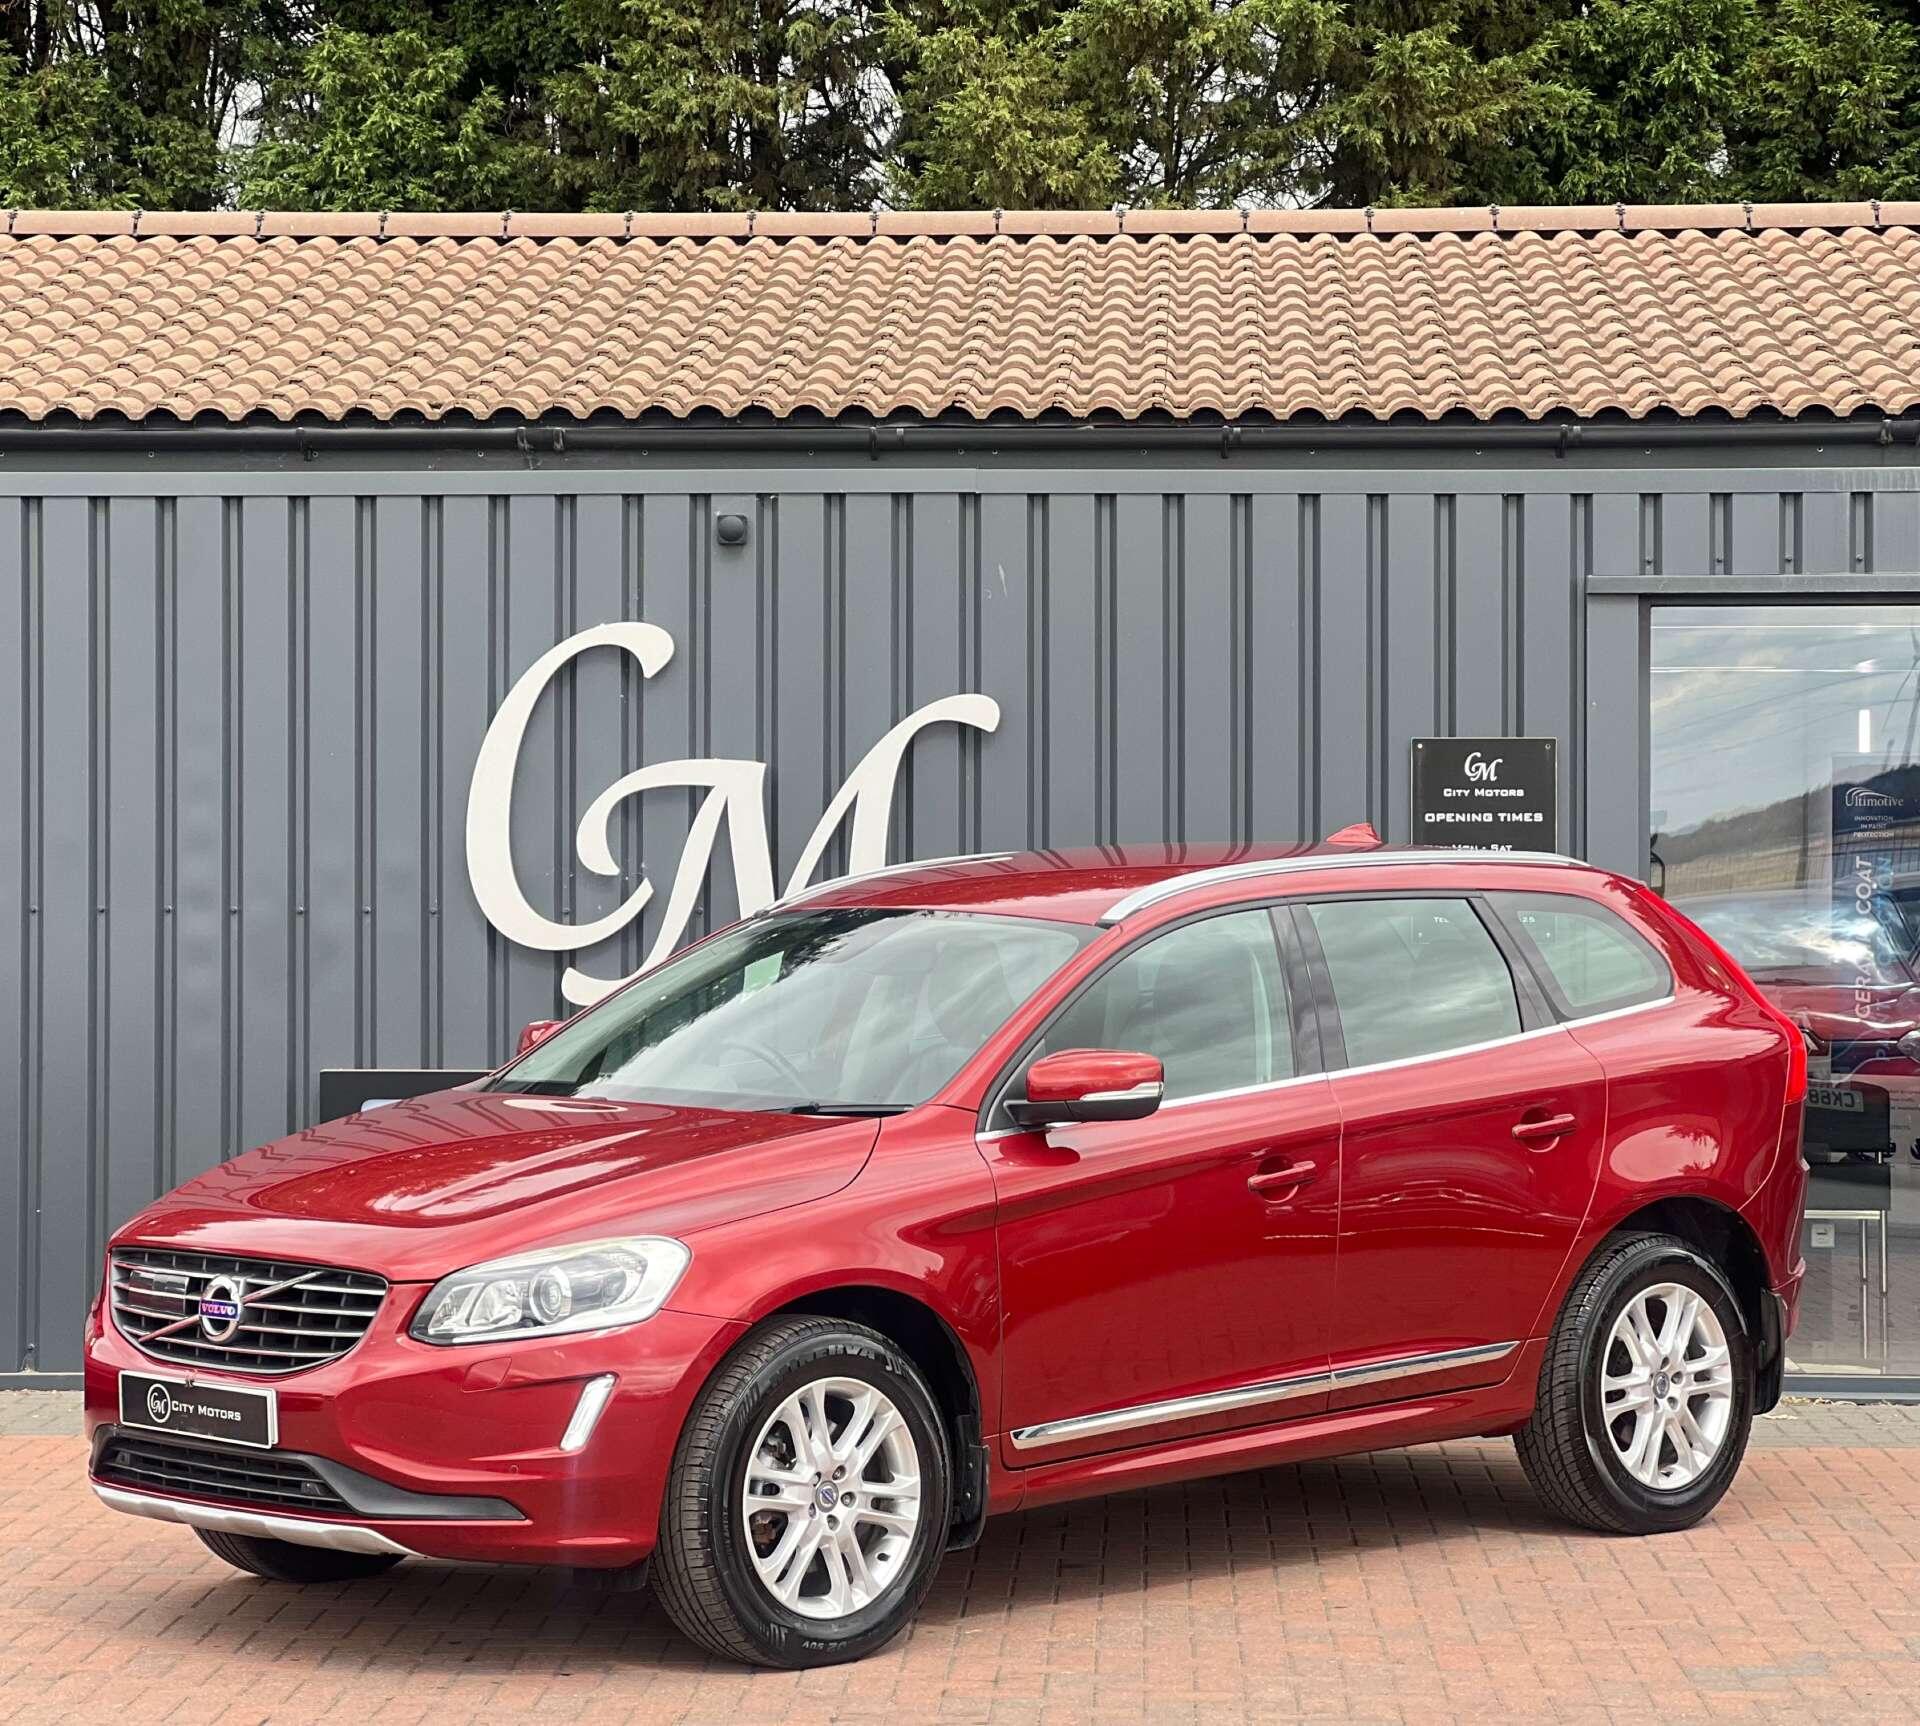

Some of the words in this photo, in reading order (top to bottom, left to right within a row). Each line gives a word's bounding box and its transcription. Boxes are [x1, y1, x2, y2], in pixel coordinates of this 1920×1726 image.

[1464, 752, 1503, 781] CM
[1443, 788, 1470, 797] CITY
[1474, 788, 1524, 797] MOTORS
[1845, 787, 1904, 807] Ultimotive
[1424, 812, 1493, 822] OPENING
[1497, 812, 1544, 822] TIMES
[1855, 856, 1872, 914] COAT
[201, 1302, 236, 1316] VOLVO
[172, 1400, 195, 1414] CITY
[198, 1404, 242, 1422] MOTORS
